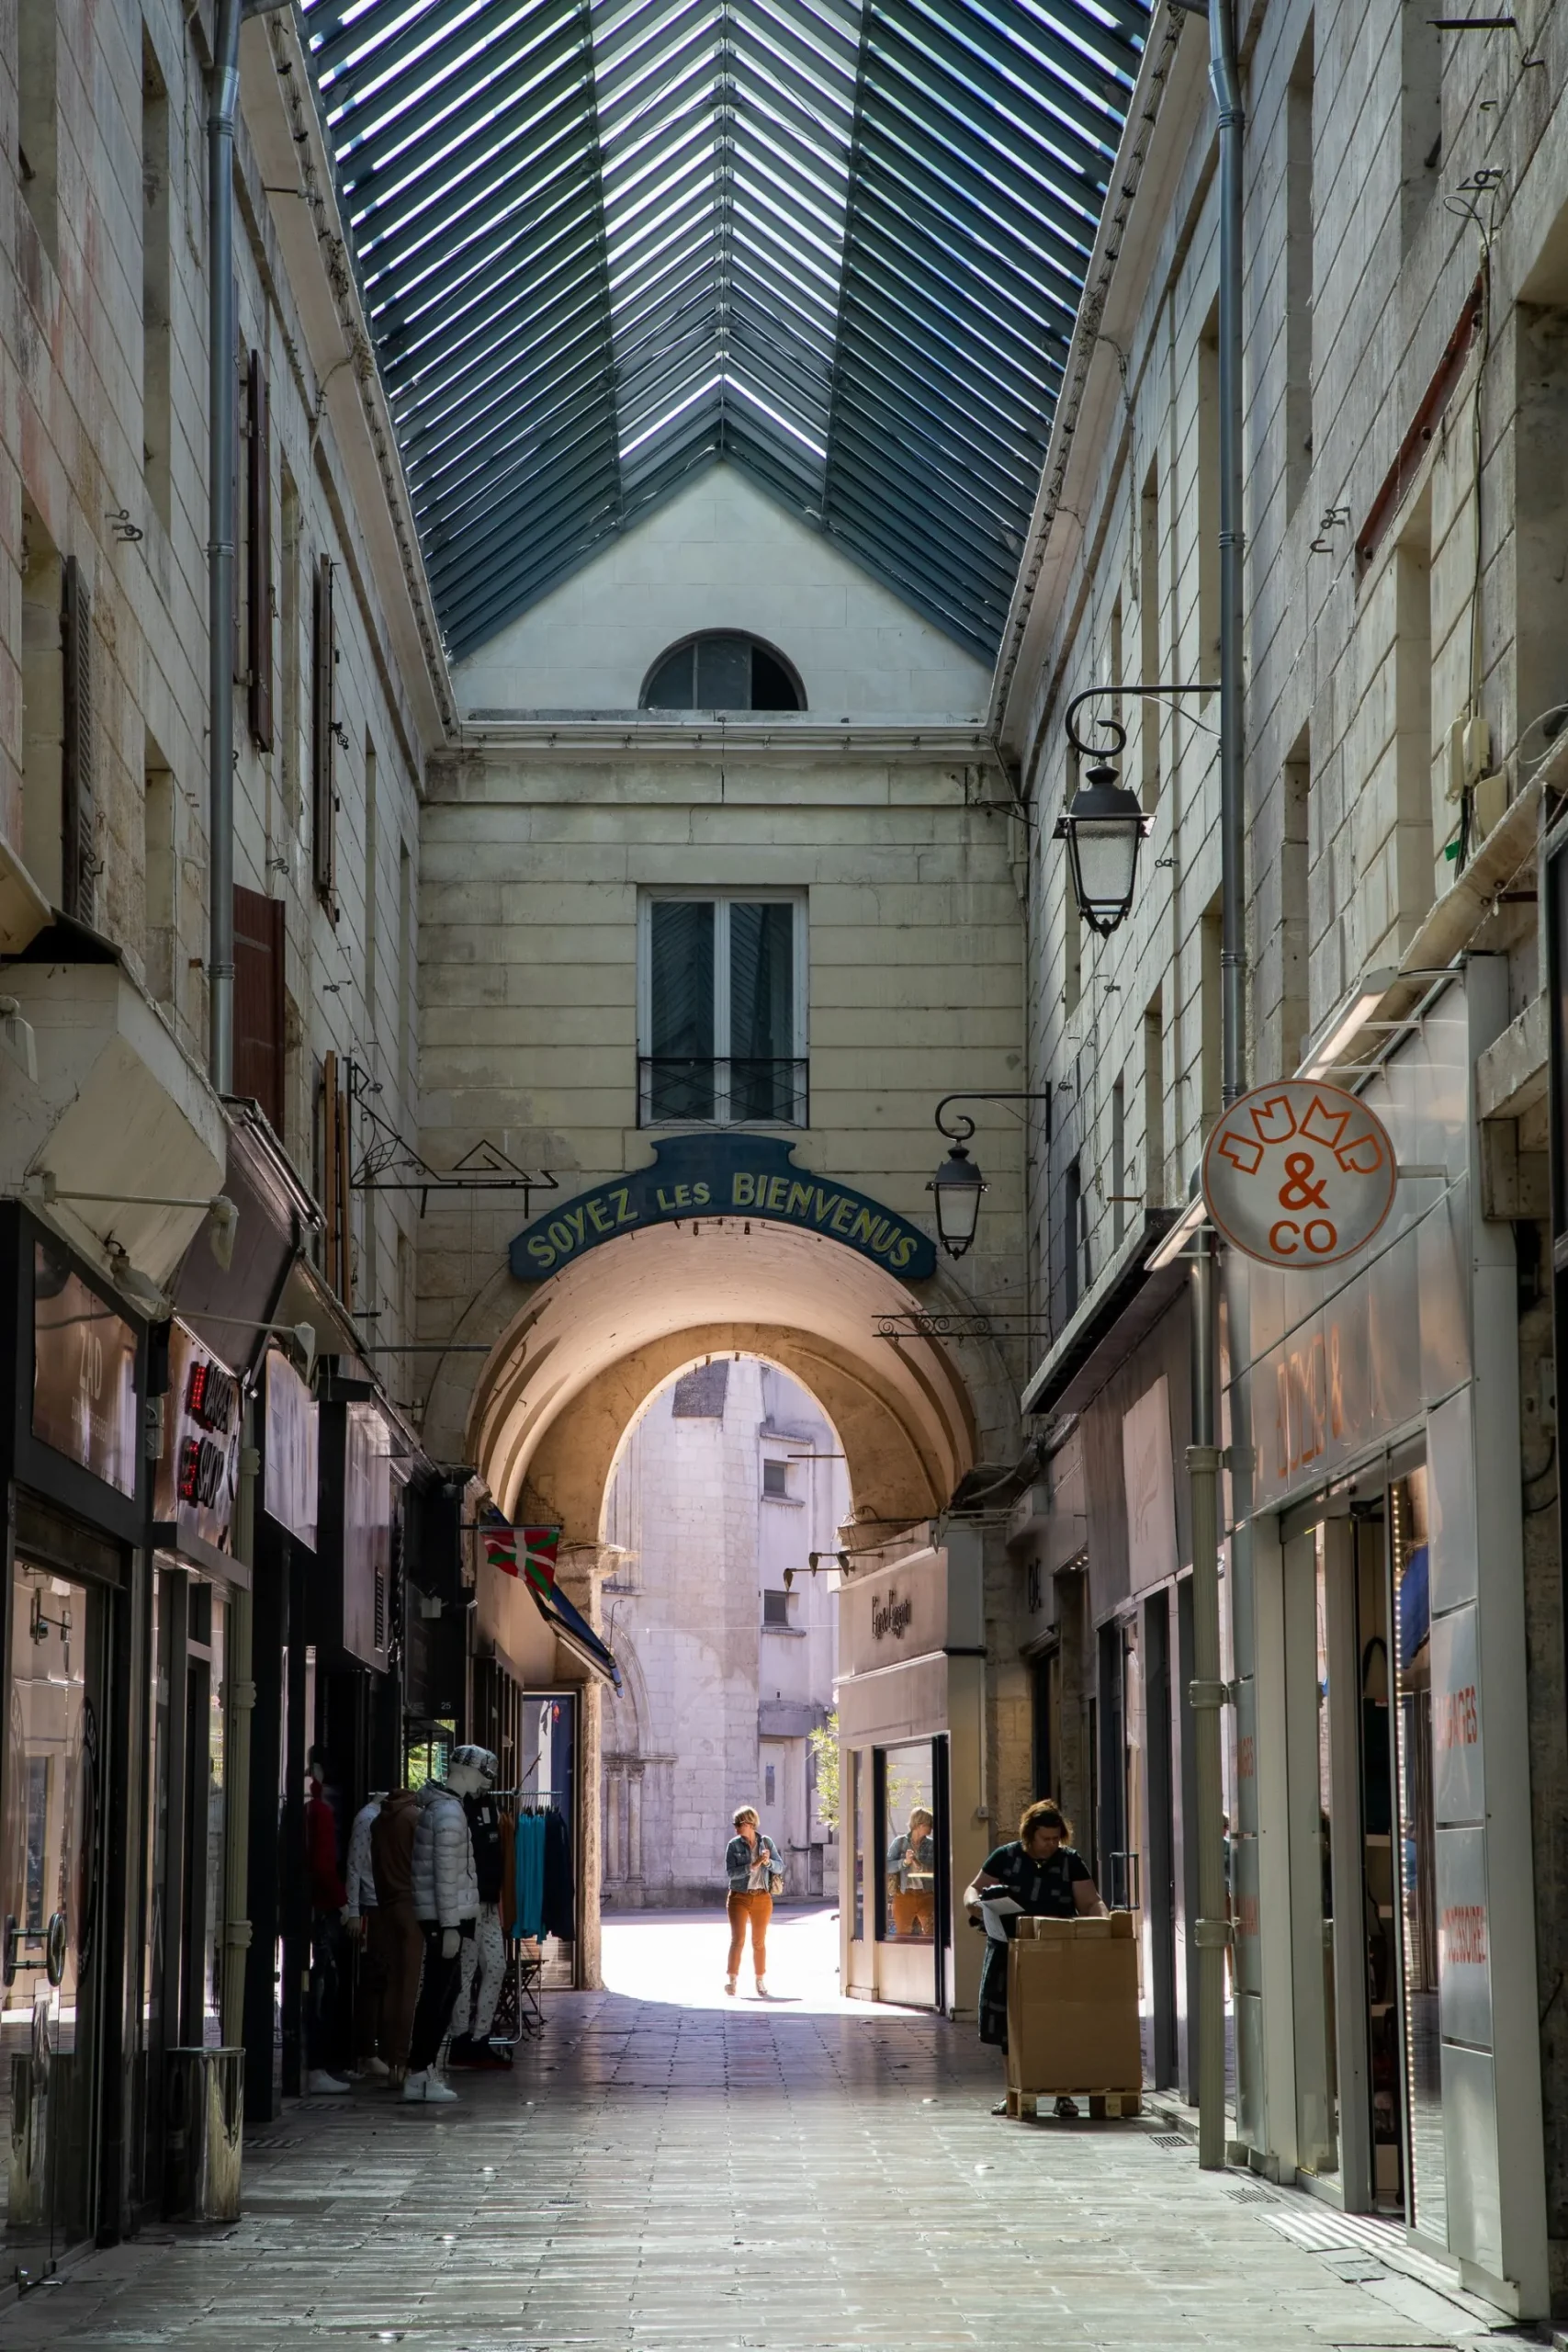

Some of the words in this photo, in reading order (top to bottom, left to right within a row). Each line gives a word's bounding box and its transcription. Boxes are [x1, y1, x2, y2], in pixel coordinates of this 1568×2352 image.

[1218, 1094, 1383, 1175] JUMP
[1279, 1152, 1330, 1211] &
[527, 1187, 638, 1268] SOYEZ
[657, 1182, 710, 1211] LES
[732, 1172, 918, 1268] BIENVENUS
[1269, 1218, 1338, 1256] CO
[79, 1324, 102, 1400] ZAD
[441, 1702, 452, 1710] 25
[1435, 1685, 1478, 1751] GAGES
